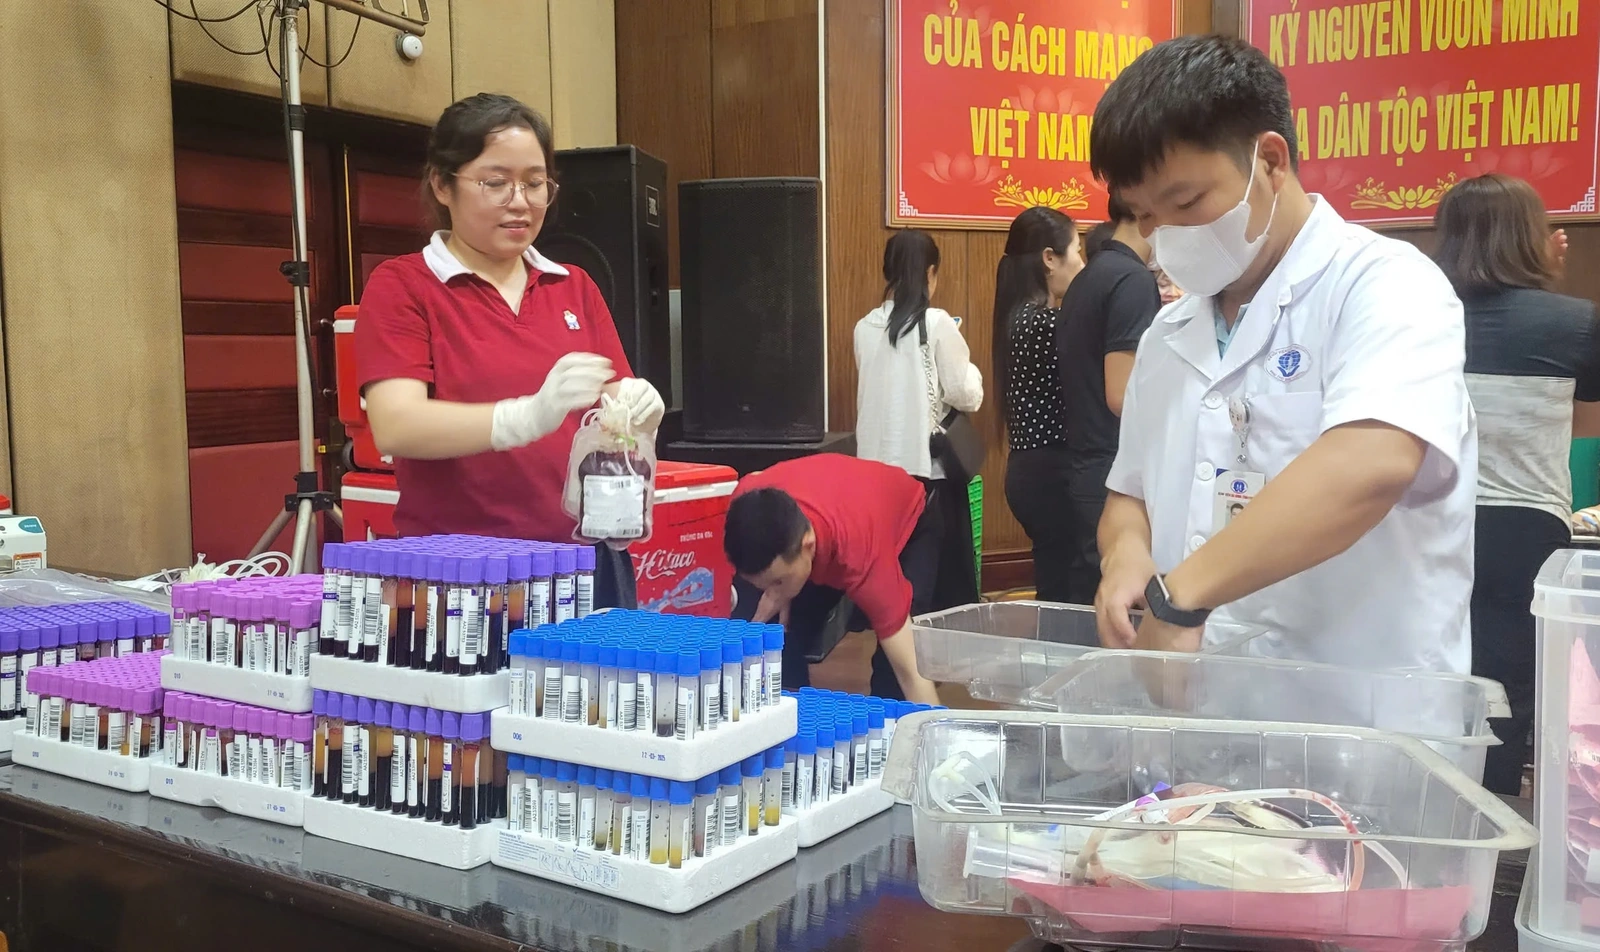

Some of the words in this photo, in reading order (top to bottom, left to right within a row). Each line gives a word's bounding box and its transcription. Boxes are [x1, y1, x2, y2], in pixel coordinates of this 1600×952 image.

[924, 2, 982, 69] CỦA
[991, 13, 1065, 76] CÁCH
[970, 99, 1030, 168] VIỆT
[1318, 92, 1371, 160] DÂN
[1378, 86, 1428, 166] TỘC
[1436, 80, 1494, 161] VIỆT
[1501, 83, 1580, 146] NAM!
